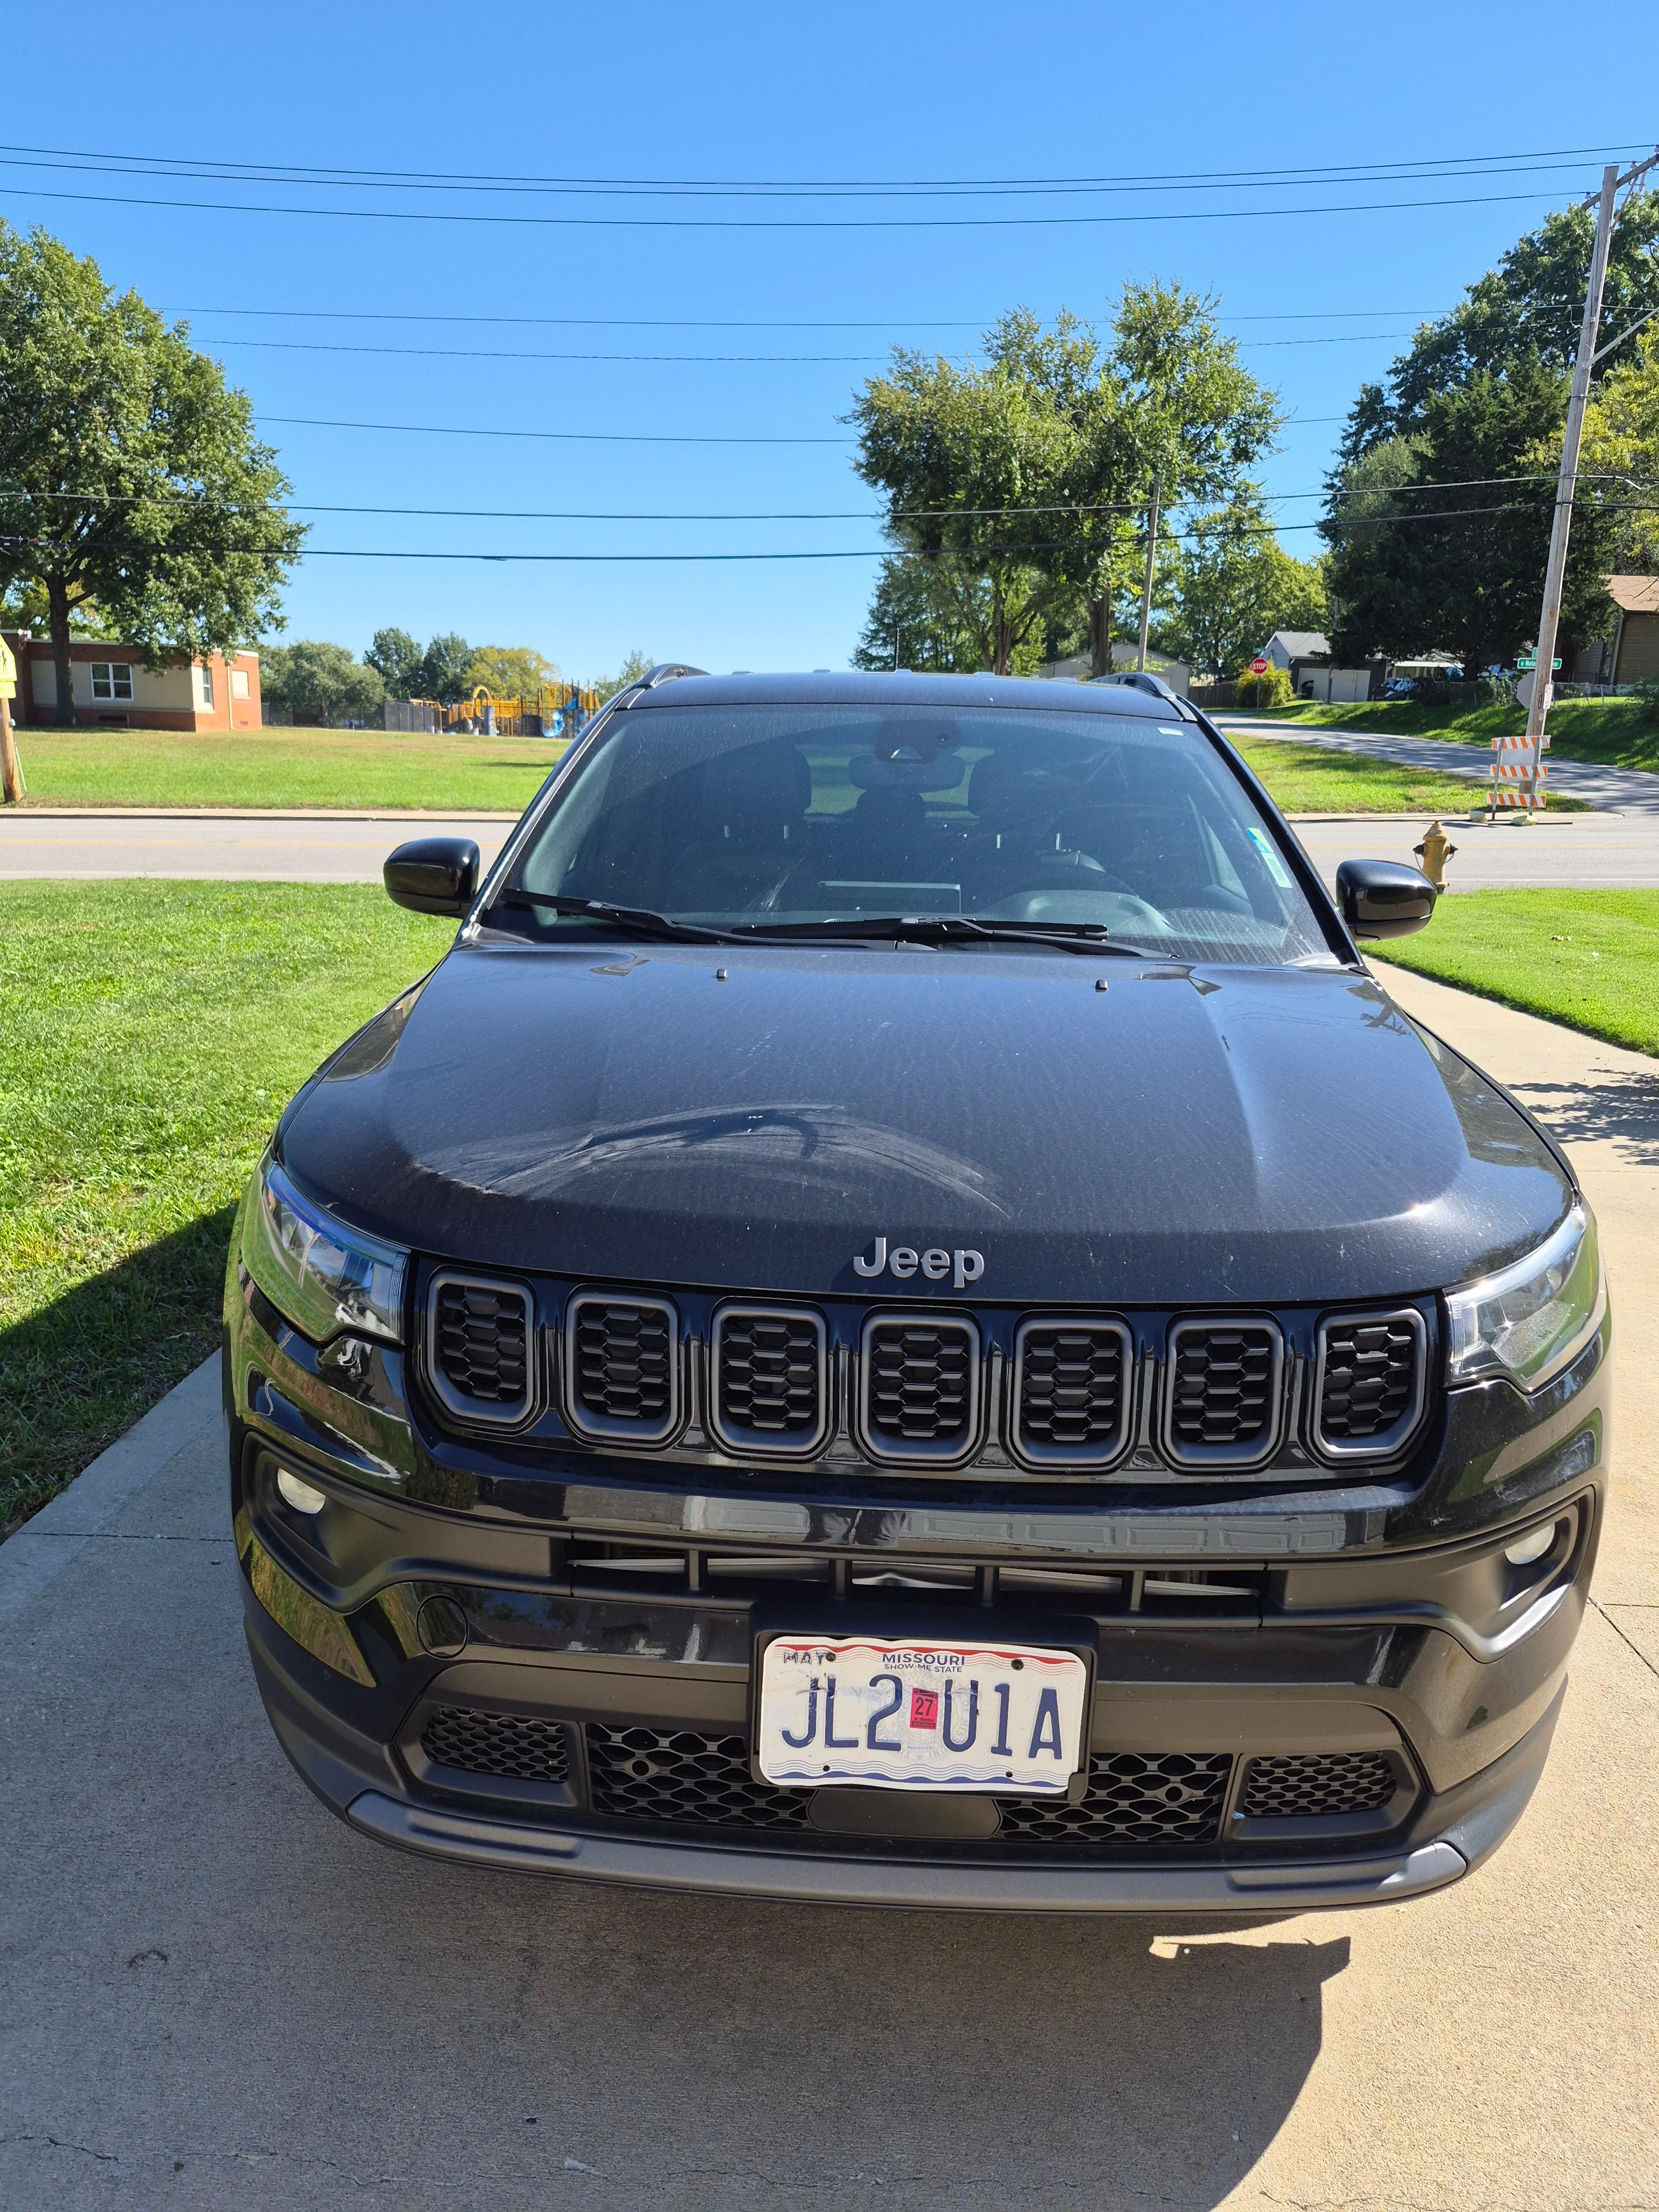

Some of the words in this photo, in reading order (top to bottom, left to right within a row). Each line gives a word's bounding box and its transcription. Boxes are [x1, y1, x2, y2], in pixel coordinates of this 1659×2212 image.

[853, 1237, 984, 1288] Jeep
[784, 1651, 826, 1666] MAY
[882, 1653, 965, 1666] MISSOURI
[781, 1673, 902, 1751] JL2
[915, 1697, 933, 1717] 27
